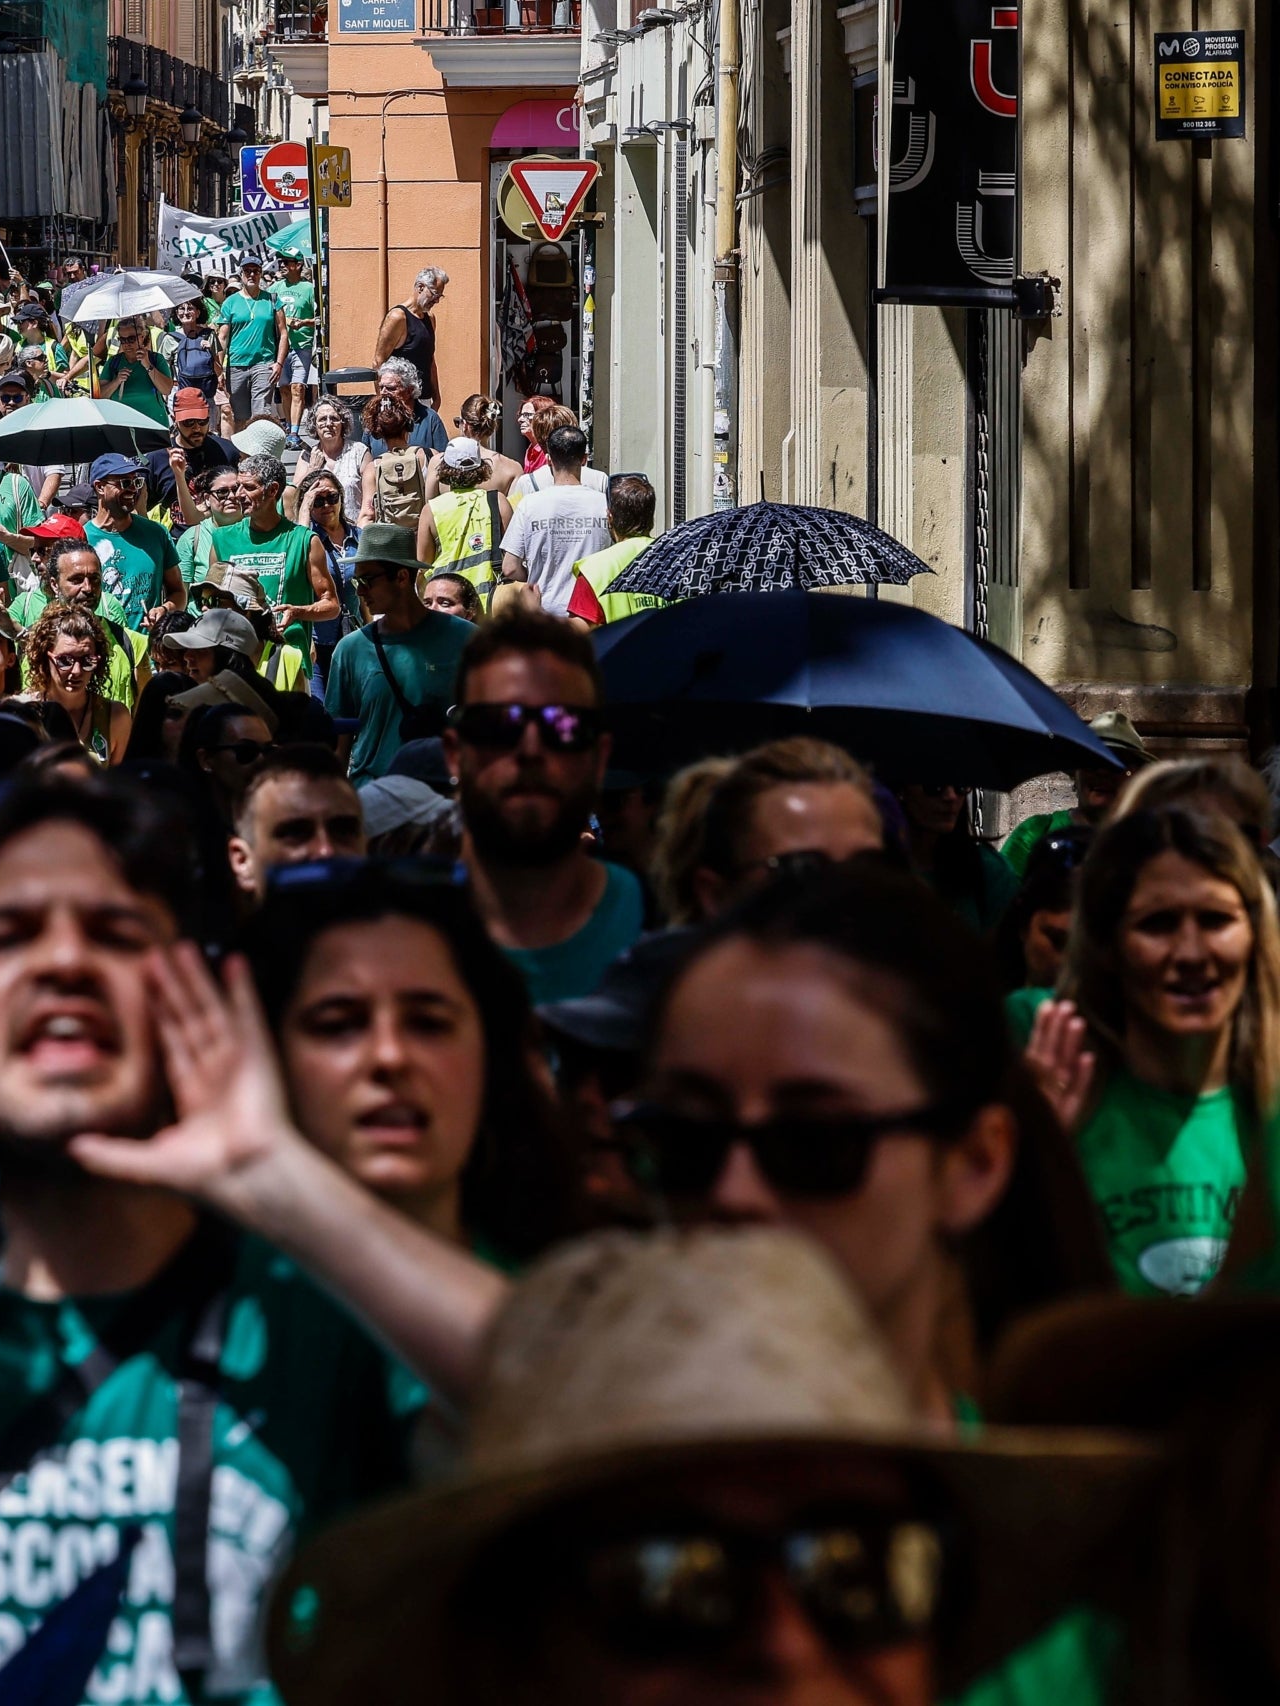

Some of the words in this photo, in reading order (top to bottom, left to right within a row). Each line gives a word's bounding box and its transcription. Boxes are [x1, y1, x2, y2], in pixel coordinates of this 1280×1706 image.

[373, 7, 385, 15] DE
[344, 20, 370, 28] SANT
[372, 19, 410, 28] MIQUEL
[1204, 42, 1239, 50] PROSEGUR
[1165, 70, 1233, 82] CONECTADA
[1208, 80, 1233, 88] POLICÍA
[171, 236, 214, 258] SIX
[218, 213, 280, 252] SEVEN
